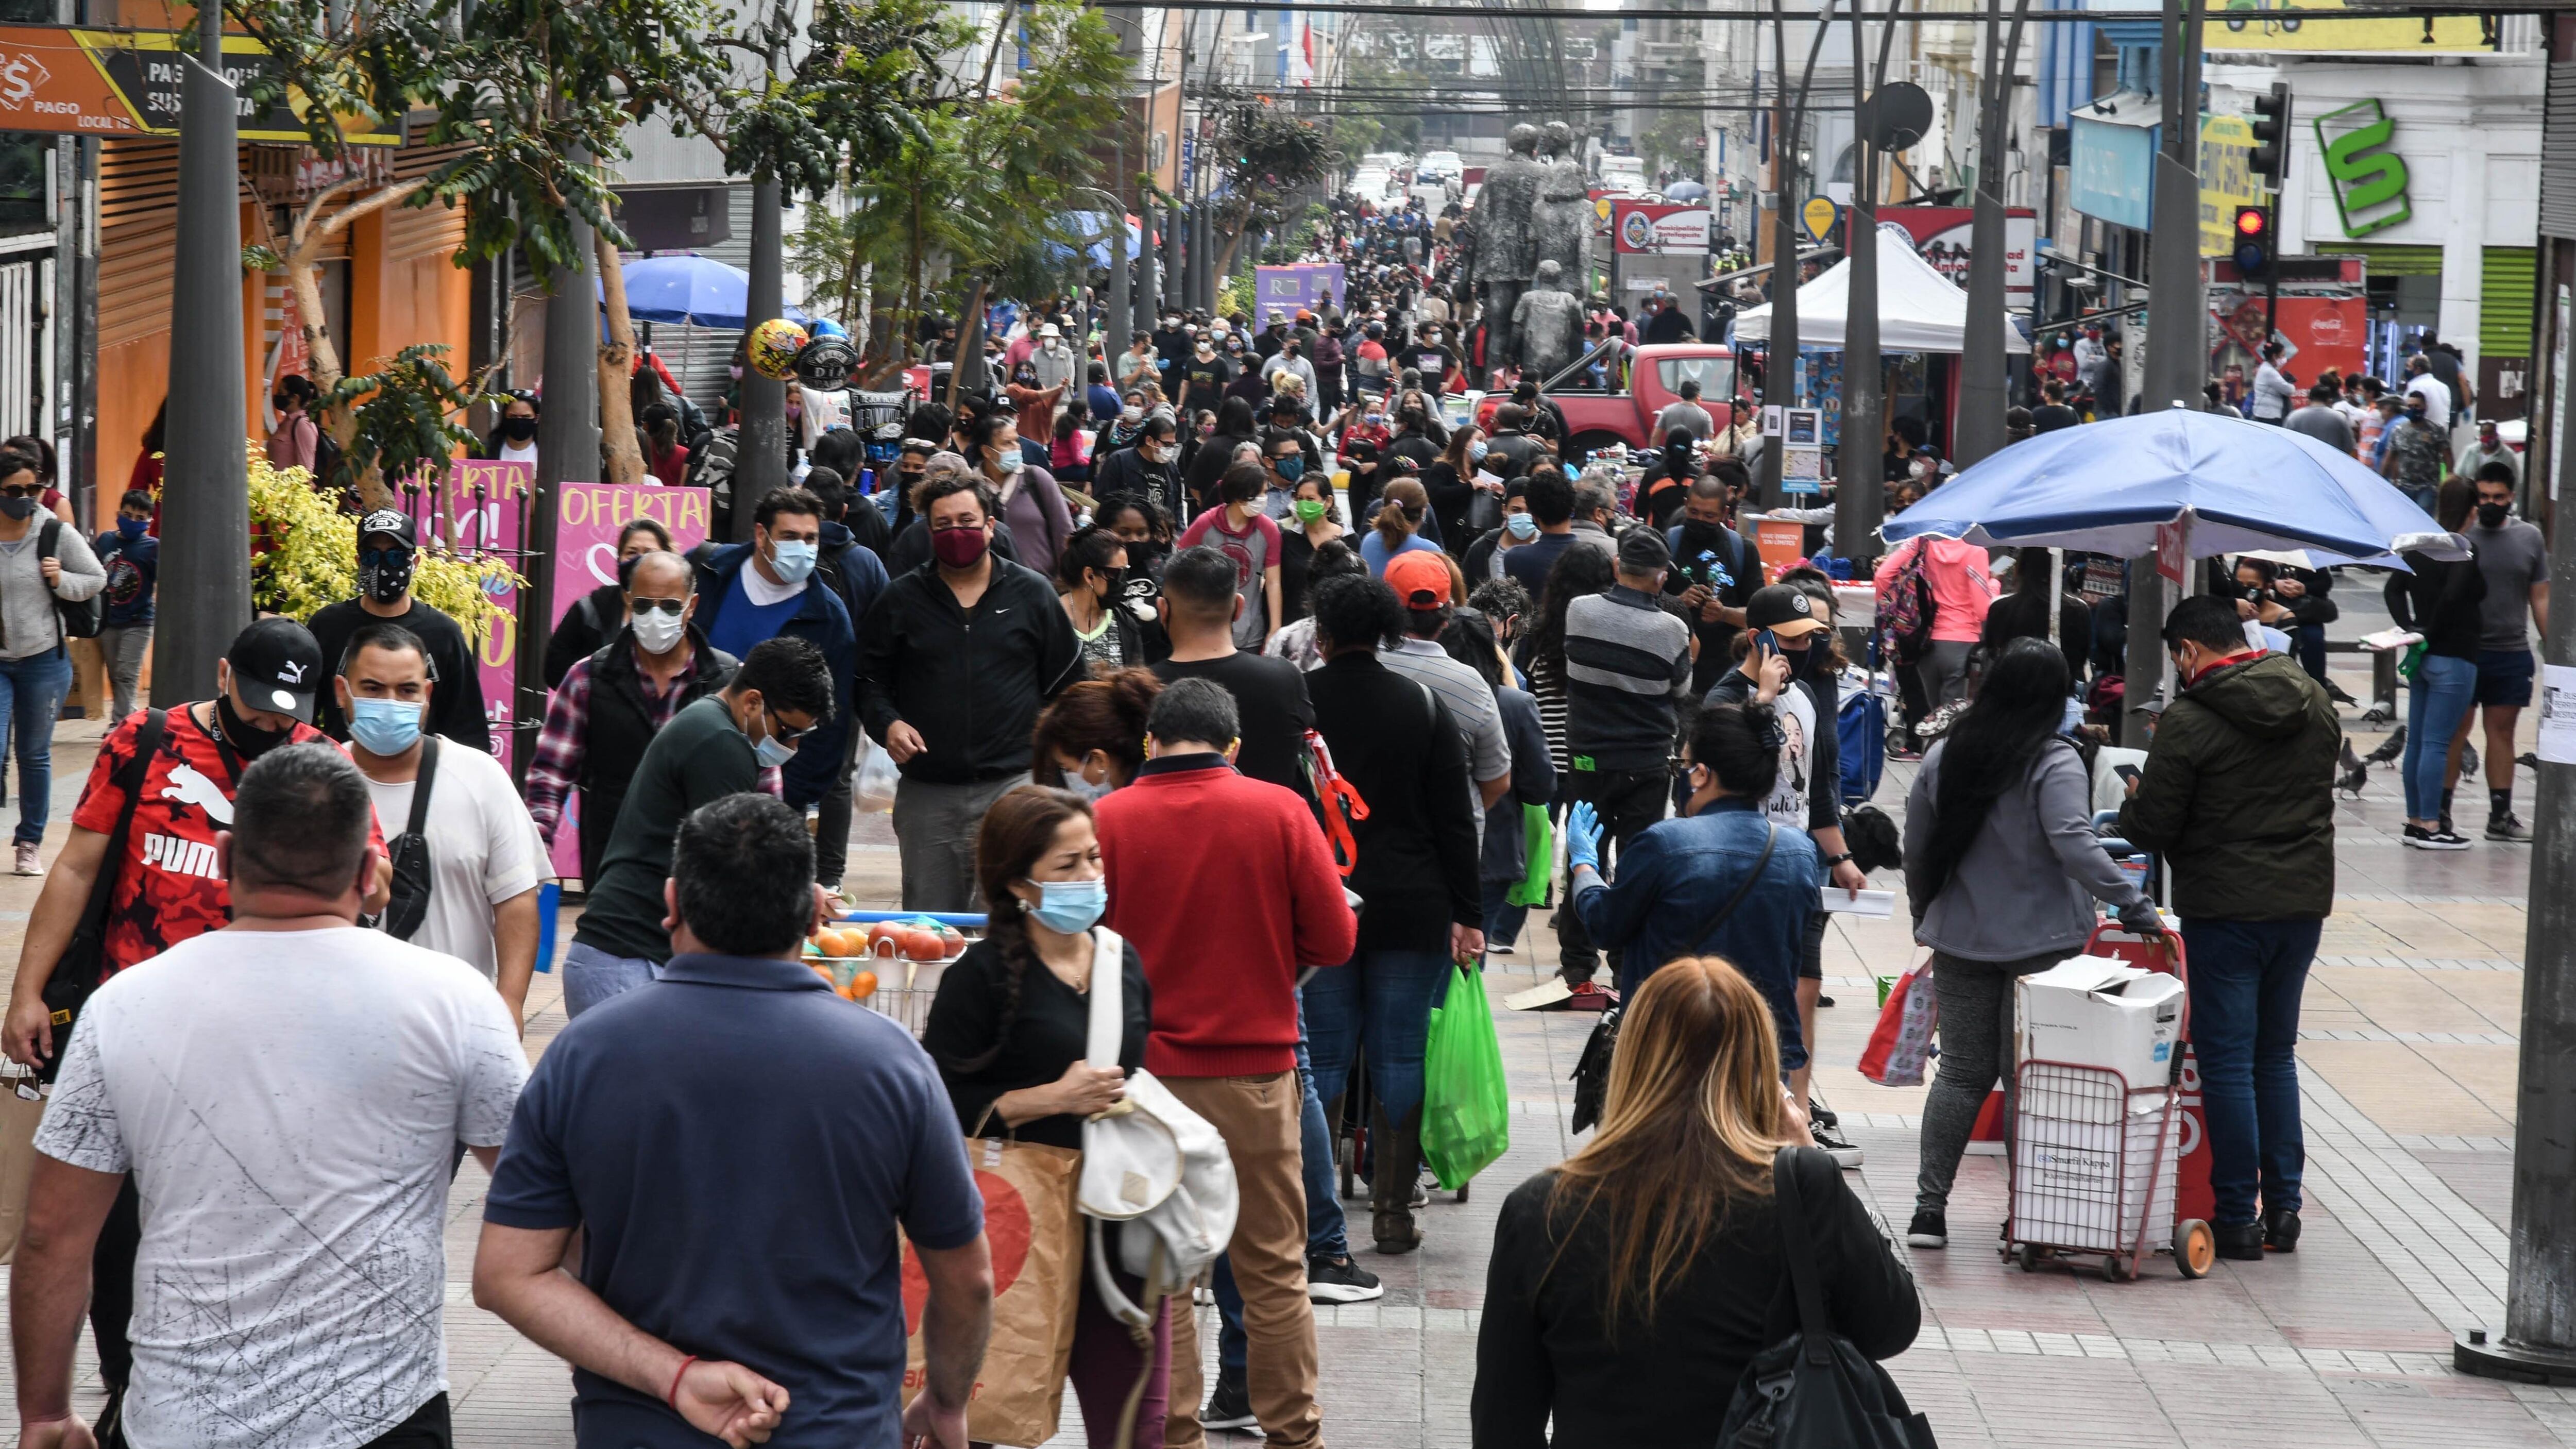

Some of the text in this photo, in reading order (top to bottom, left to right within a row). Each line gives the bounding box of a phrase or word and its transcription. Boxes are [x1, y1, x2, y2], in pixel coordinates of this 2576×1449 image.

[34, 101, 80, 114] PAGO
[78, 115, 113, 129] LOCAL
[563, 488, 705, 529] OFERTA
[277, 671, 297, 684] PUMA
[141, 832, 222, 880] PUM
[2082, 1157, 2111, 1170] Kappa
